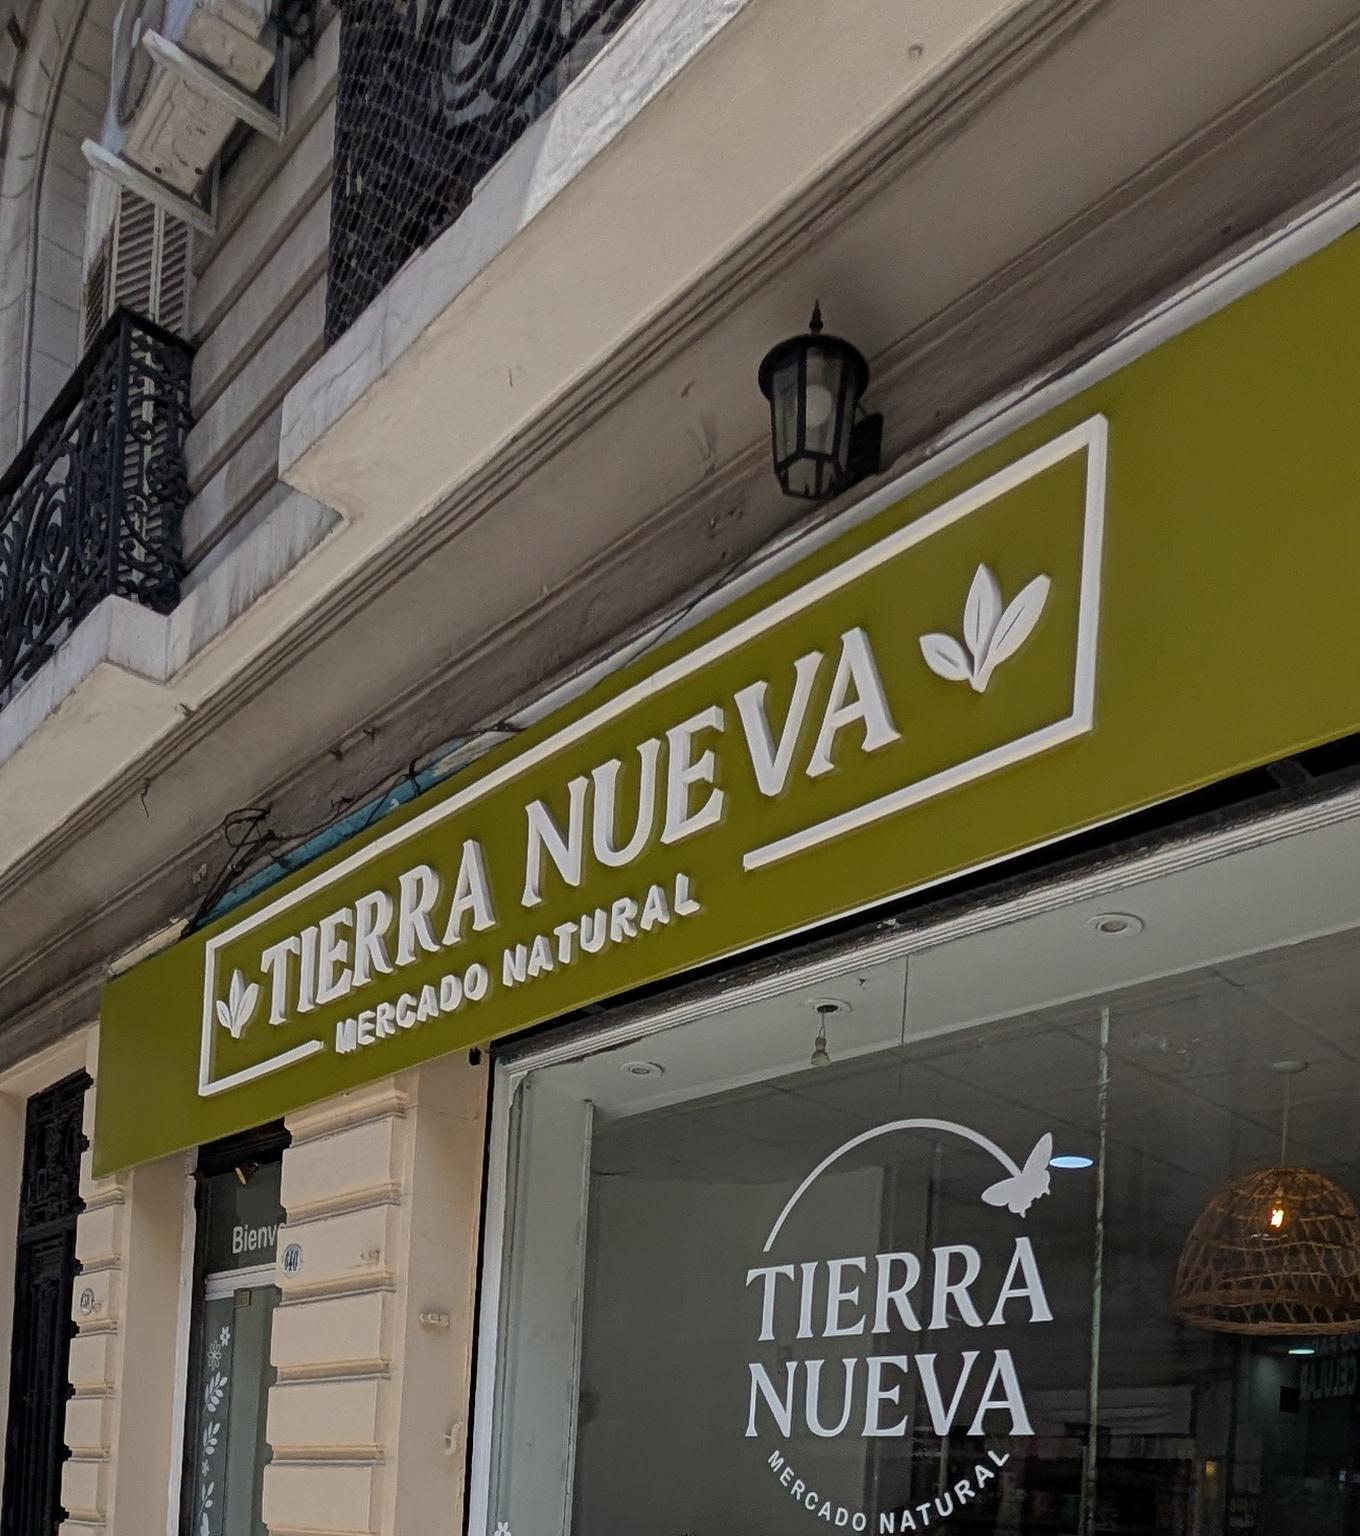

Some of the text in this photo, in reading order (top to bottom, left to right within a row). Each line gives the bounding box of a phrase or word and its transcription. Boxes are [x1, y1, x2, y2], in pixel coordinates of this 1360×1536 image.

[259, 626, 901, 1029] TIERRA NUEVA
[335, 872, 702, 1055] MERCADO NATURAL
[745, 1237, 1054, 1341] TIERRA
[745, 1349, 1036, 1438] NUEVA
[767, 1449, 1010, 1535] MERCADO NATURAL
